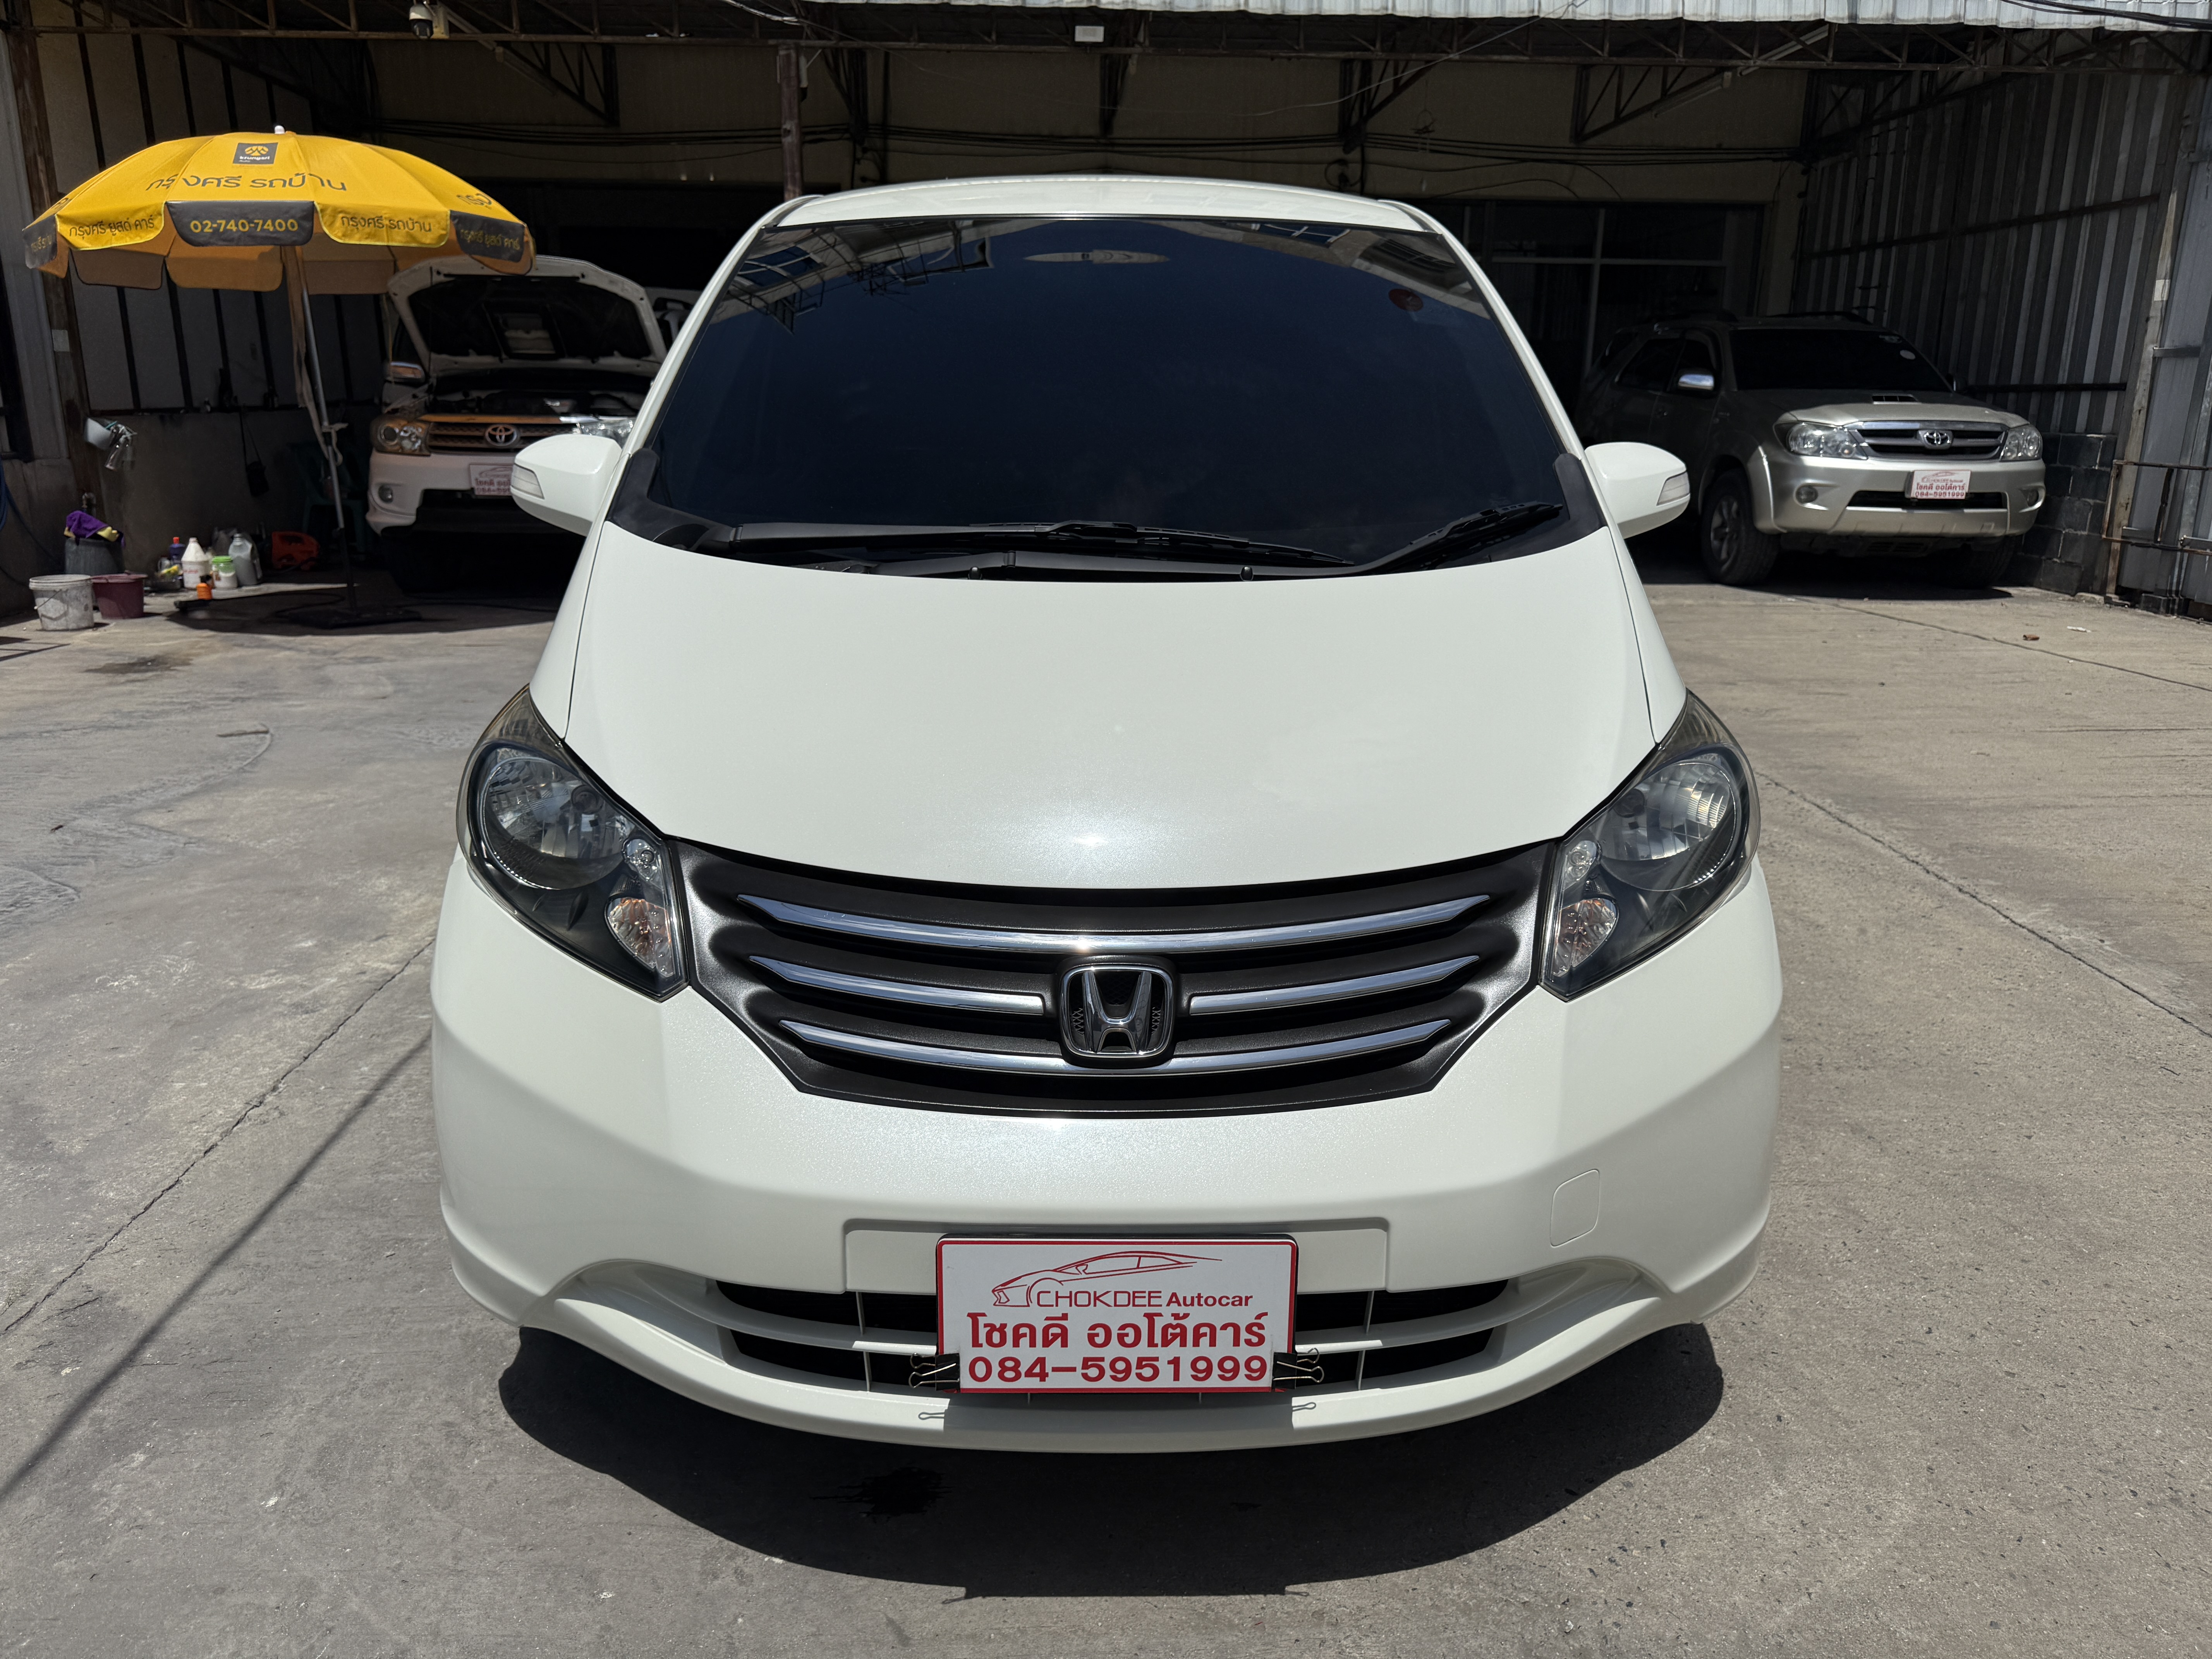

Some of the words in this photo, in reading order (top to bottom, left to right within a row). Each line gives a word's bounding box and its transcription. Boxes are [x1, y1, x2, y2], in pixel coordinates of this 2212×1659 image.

[69, 220, 107, 240] กรุงศรี
[135, 214, 155, 230] คาร์
[189, 219, 299, 233] 02-740-7400
[341, 215, 385, 230] กรุงศรี
[388, 217, 432, 232] รถบ้าน
[1037, 1290, 1162, 1307] CHOKDEE
[1166, 1292, 1253, 1307] Autocar
[967, 1312, 1068, 1348] โชคดี
[1087, 1312, 1268, 1348] ออโต้คาร์
[968, 1355, 1267, 1382] 084-5951999
